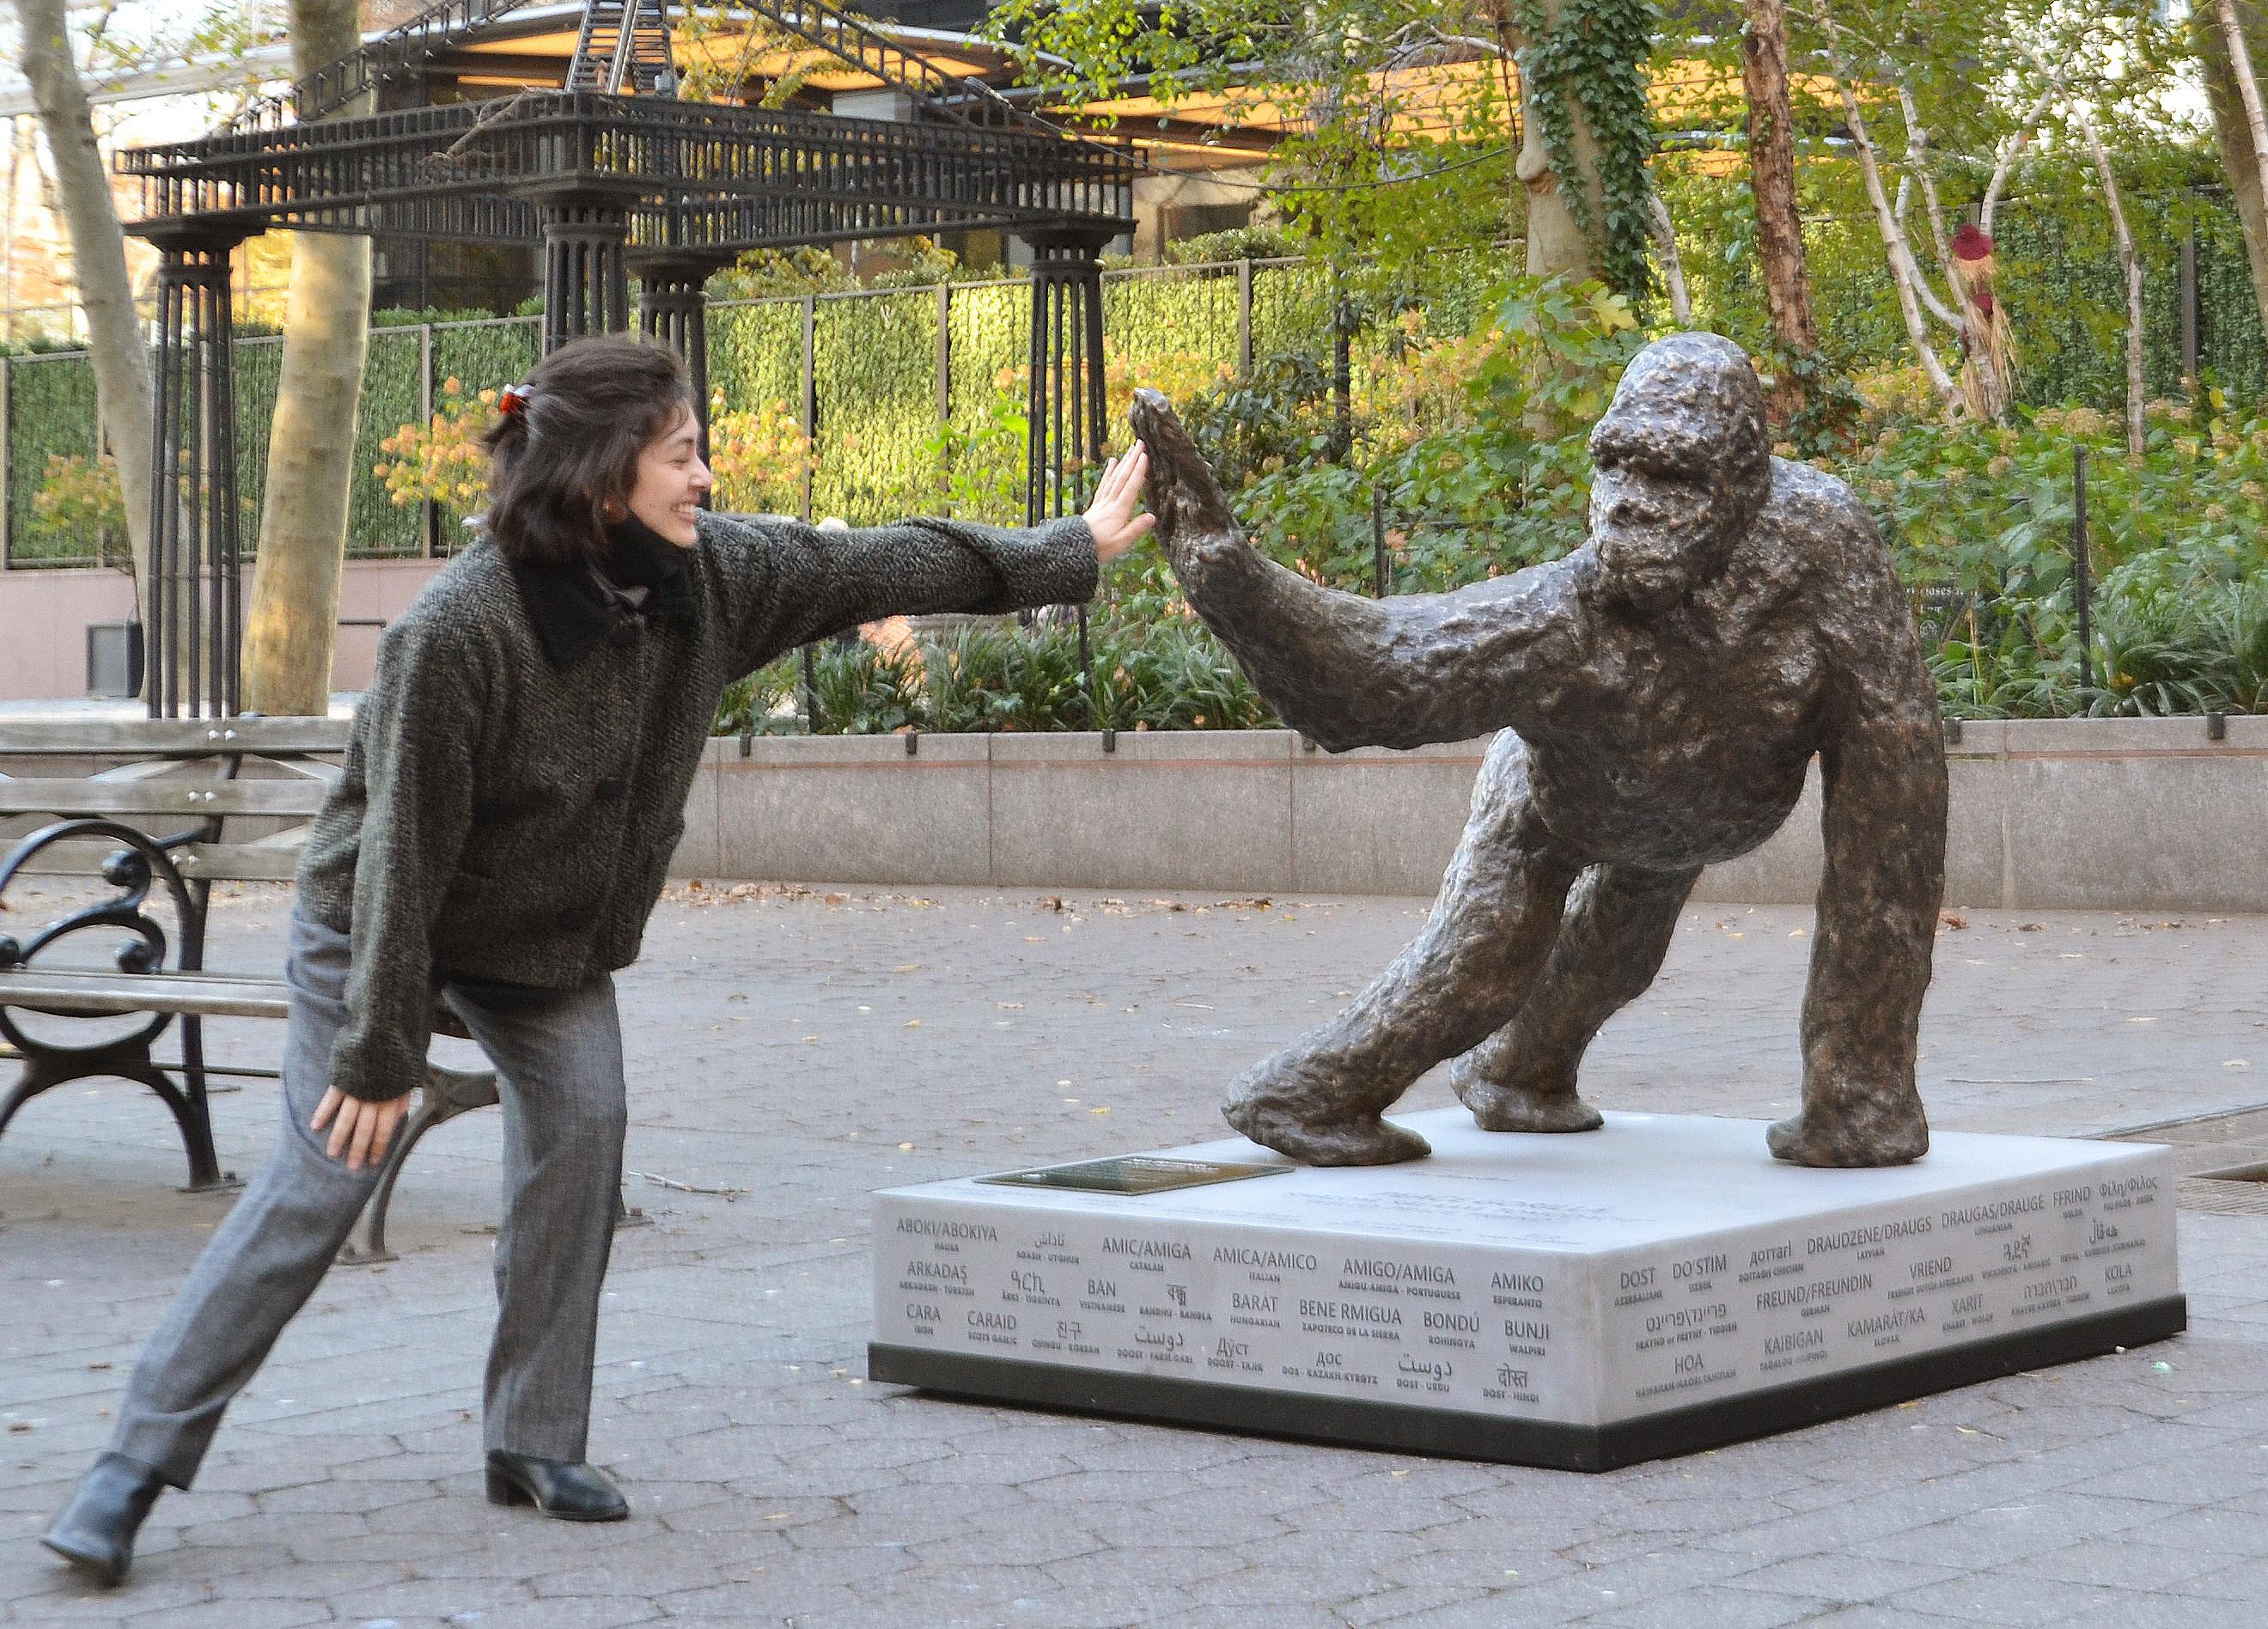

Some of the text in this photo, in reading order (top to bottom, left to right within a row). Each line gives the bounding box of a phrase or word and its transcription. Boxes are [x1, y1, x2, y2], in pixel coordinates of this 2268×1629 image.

[2052, 1187, 2090, 1207] FFRIND
[897, 1217, 997, 1242] ABOKI/ABOKIYA
[1808, 1216, 1931, 1255] DRAUDZENE/DRAUGS
[935, 1242, 959, 1251] HAUSA
[1102, 1237, 1191, 1260] AMIC/AMIGA
[1856, 1248, 1885, 1261] LATVIAN
[1129, 1261, 1164, 1272] CATALAN
[1213, 1247, 1317, 1271] AMICA/AMICO
[1673, 1254, 1727, 1279] DO'STIM
[1910, 1257, 1951, 1278] VRIEND
[907, 1261, 967, 1285] ARKADAŞ
[1249, 1272, 1280, 1283] ITALIAN
[1343, 1259, 1455, 1284] AMIGO/AMIGA
[1620, 1266, 1655, 1290] DOST
[2105, 1263, 2131, 1283] KOLA
[1088, 1278, 1116, 1296] BAN
[1491, 1272, 1544, 1293] AMIKO
[1756, 1272, 1873, 1310] FREUND/FREUNDIN
[1232, 1291, 1277, 1313] BARÁT
[1406, 1287, 1460, 1300] PORTUGUESE
[1493, 1295, 1542, 1309] ESPERANTO
[906, 1303, 941, 1321] CARA
[1299, 1299, 1402, 1325] BENE RMIGUA
[1801, 1304, 1830, 1317] GERMAN
[1952, 1294, 1982, 1315] XARIT
[914, 1325, 933, 1333] IRISH
[967, 1310, 1016, 1330] CARAID
[1230, 1315, 1280, 1328] HUNGARIAN
[1424, 1311, 1479, 1333] BONDÚ
[1504, 1319, 1549, 1340] BUNJI
[1135, 1326, 1184, 1351] دوست
[1302, 1322, 1399, 1340] ZAPOTECO DE LA SIERRA
[1764, 1327, 1823, 1355] KAIBIGAN
[1068, 1343, 1100, 1354] KOREAN
[1428, 1335, 1475, 1349] ROHINGYA
[1117, 1349, 1143, 1359] DOOST
[1674, 1353, 1704, 1374] HOA
[1399, 1353, 1453, 1382] دوست
[1497, 1363, 1527, 1388] दोस्त
[1396, 1378, 1449, 1392] DOST URDU
[1483, 1388, 1540, 1403] DOST HINDI
